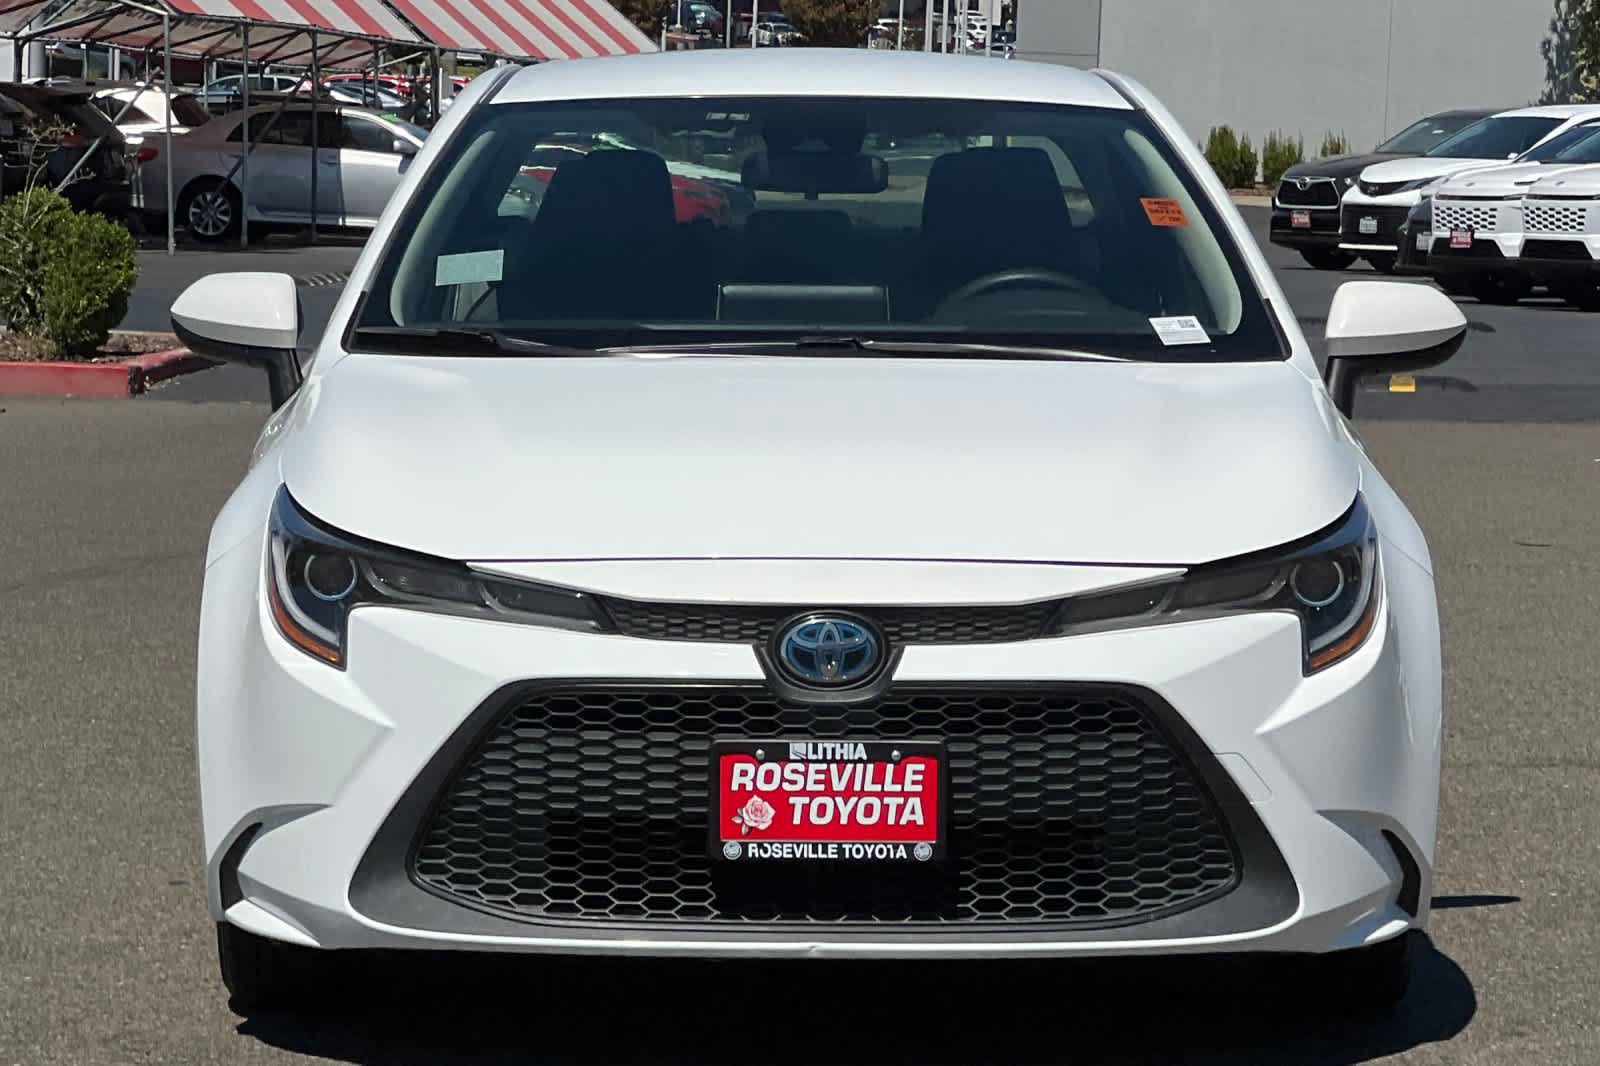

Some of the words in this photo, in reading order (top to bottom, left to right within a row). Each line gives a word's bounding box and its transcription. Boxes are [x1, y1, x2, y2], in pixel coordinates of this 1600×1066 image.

[808, 743, 867, 760] LITHIA
[731, 763, 925, 792] ROSEVILLE
[789, 796, 925, 825] TOYOTA
[748, 843, 838, 859] ROSEVILLE
